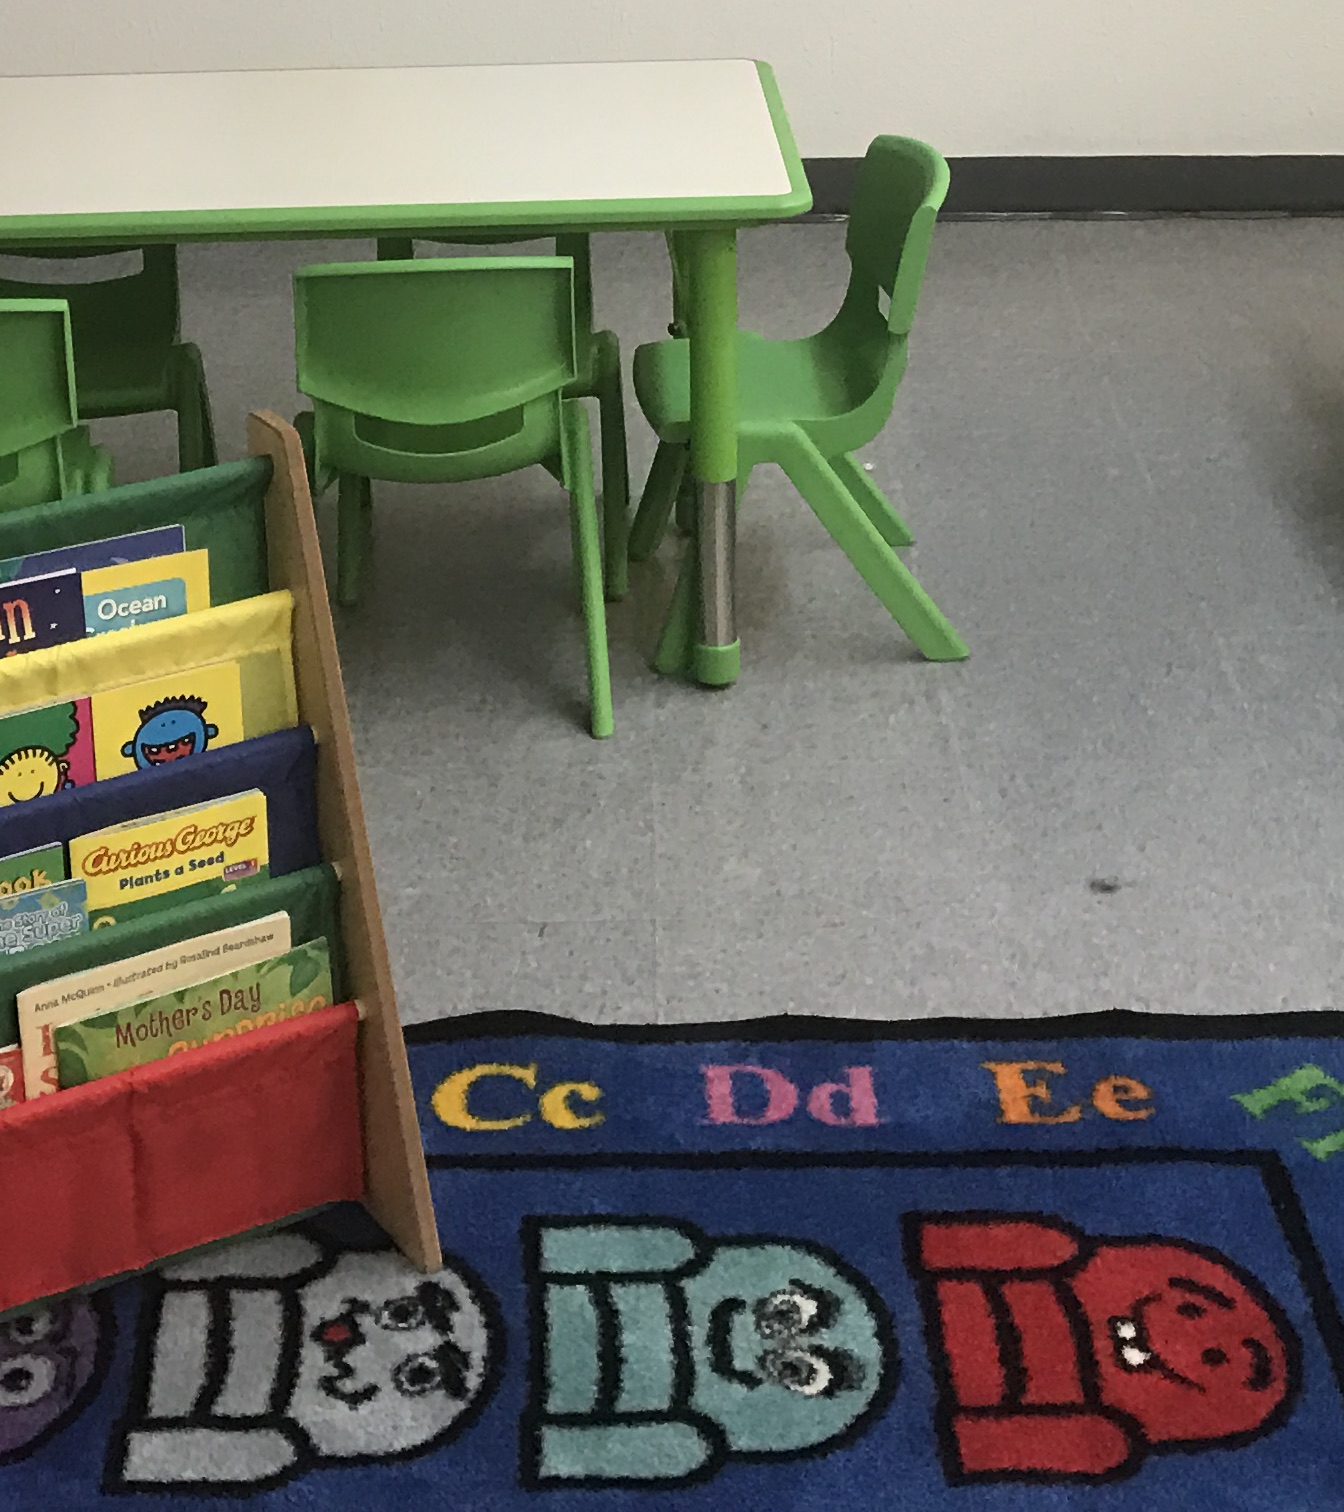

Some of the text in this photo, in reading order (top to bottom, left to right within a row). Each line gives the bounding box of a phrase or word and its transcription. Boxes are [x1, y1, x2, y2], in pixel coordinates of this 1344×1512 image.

[97, 593, 167, 621] Ocean
[82, 816, 256, 877] Curious George
[119, 851, 224, 890] Plants a Seed
[14, 909, 50, 929] Story
[51, 901, 68, 920] of
[19, 913, 84, 944] Super
[34, 1000, 59, 1013] Anna
[165, 960, 178, 972] by
[179, 947, 220, 965] Rosalind
[115, 982, 261, 1048] Mother's Day
[431, 1062, 608, 1131] Cc
[700, 1063, 889, 1127] Dd
[979, 1060, 1166, 1125] Ee
